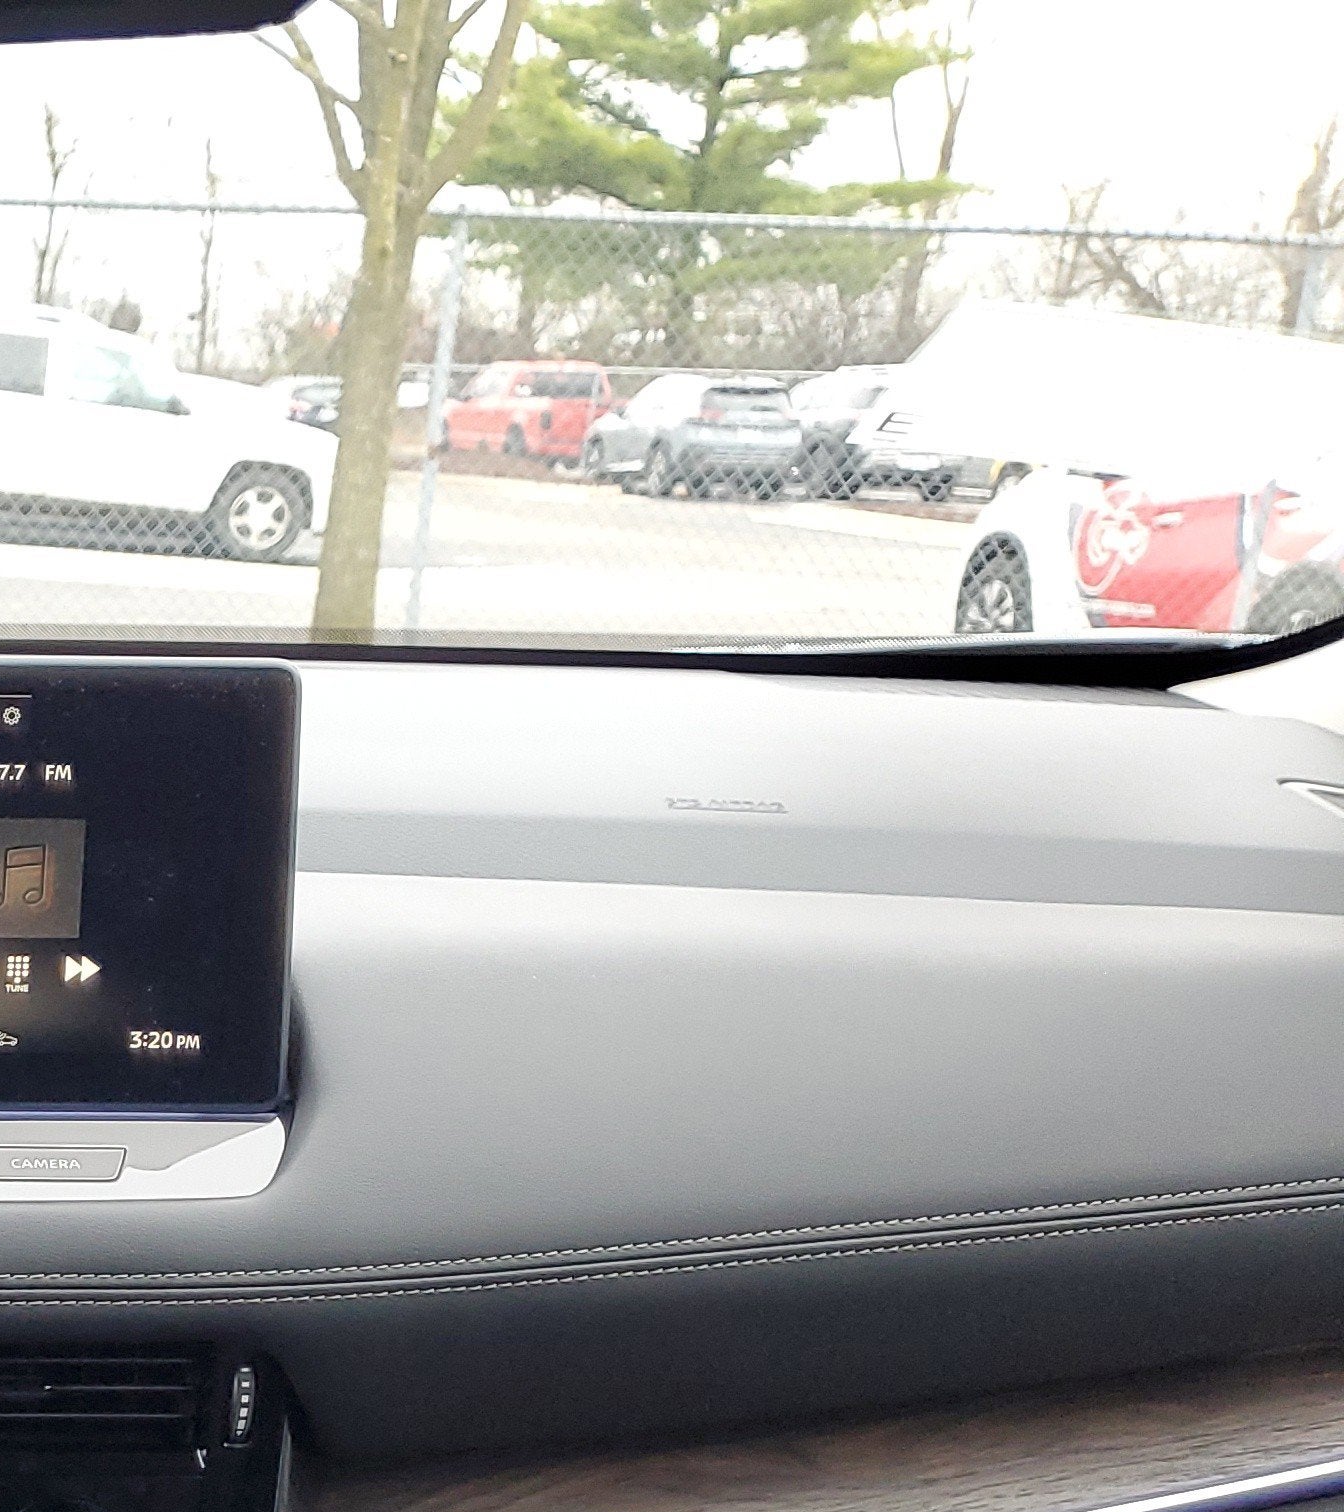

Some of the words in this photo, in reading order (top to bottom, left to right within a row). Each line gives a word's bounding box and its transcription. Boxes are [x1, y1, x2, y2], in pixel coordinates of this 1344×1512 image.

[45, 765, 72, 781] FM
[5, 984, 29, 993] TUNE
[130, 1031, 173, 1049] 3:20
[176, 1035, 200, 1049] PM
[11, 1158, 81, 1169] CAMERA
